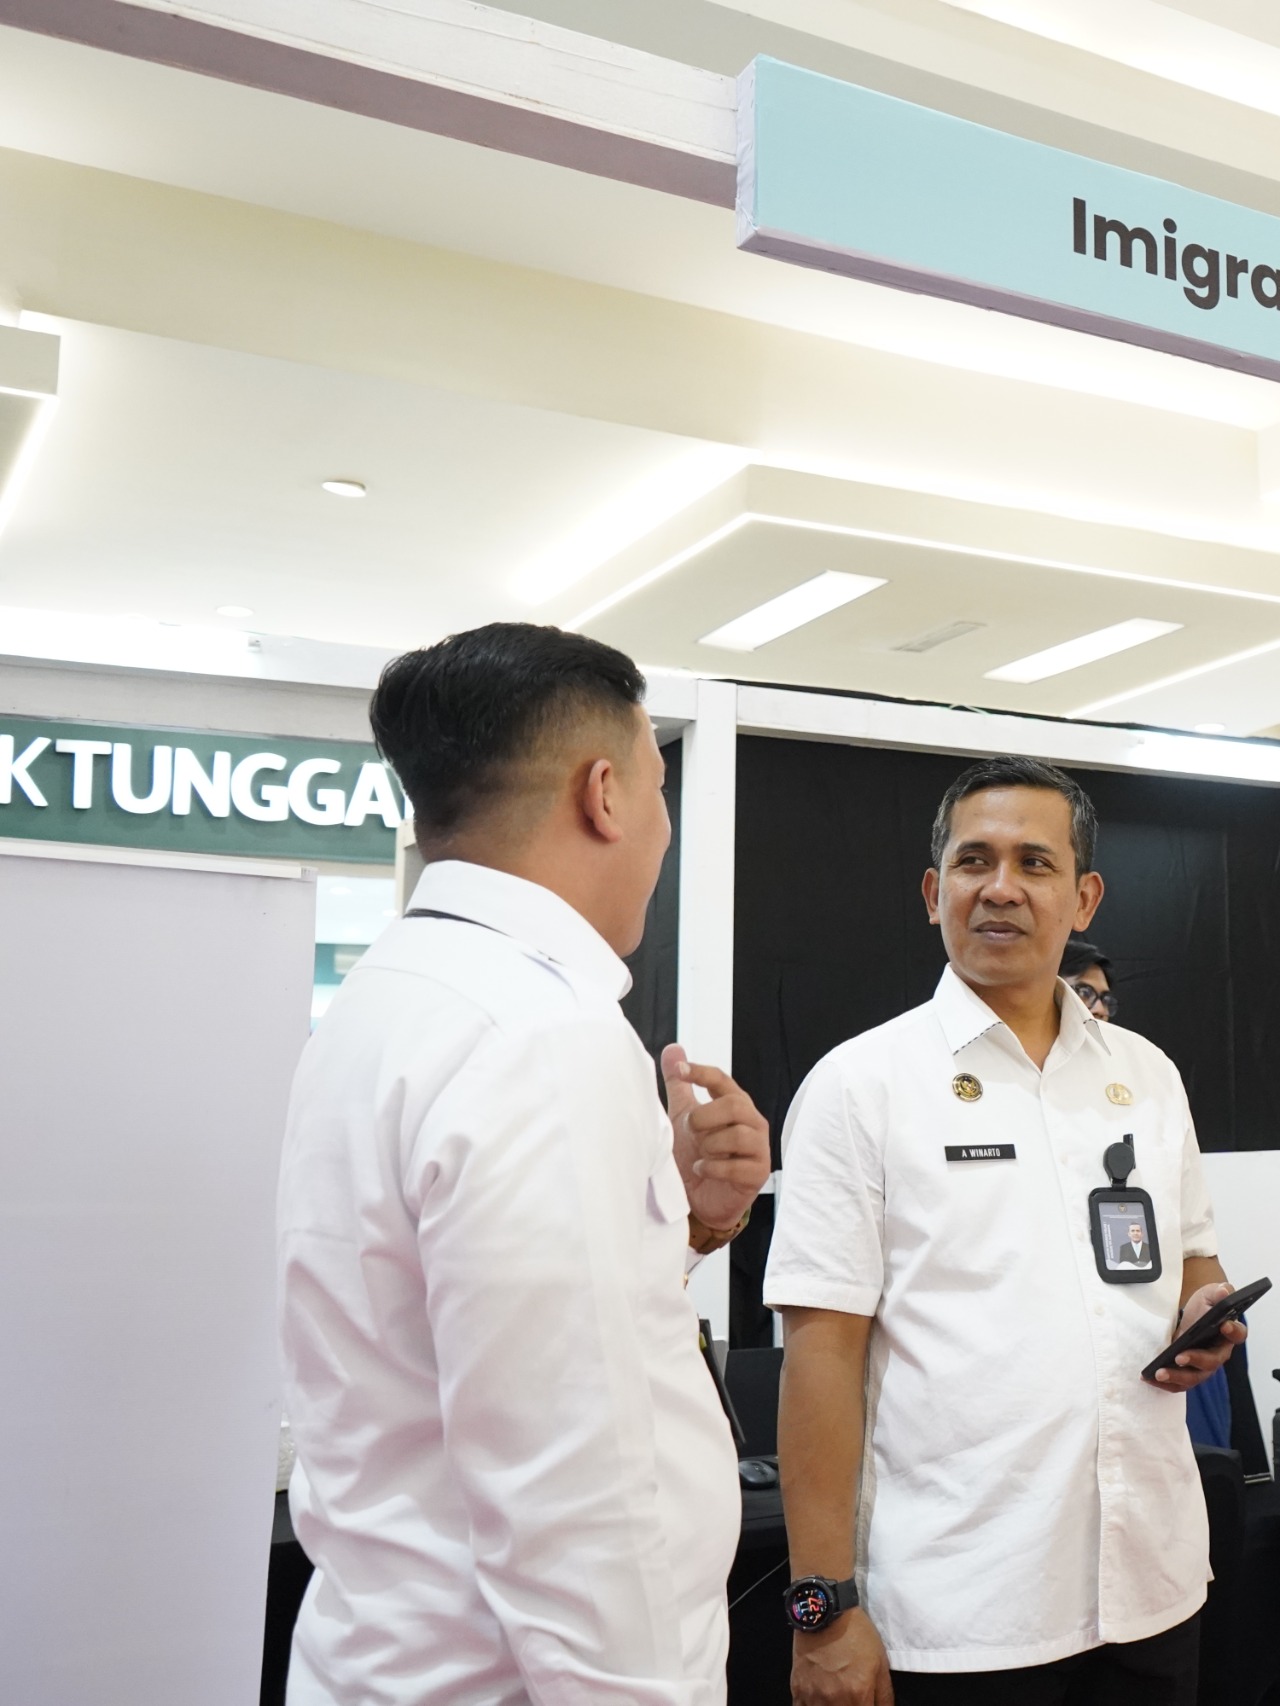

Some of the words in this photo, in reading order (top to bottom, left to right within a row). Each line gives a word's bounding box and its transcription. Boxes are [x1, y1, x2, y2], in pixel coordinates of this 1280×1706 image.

[55, 739, 415, 829] TUNGGA
[961, 1149, 968, 1158] A
[969, 1148, 1001, 1158] WINARTO
